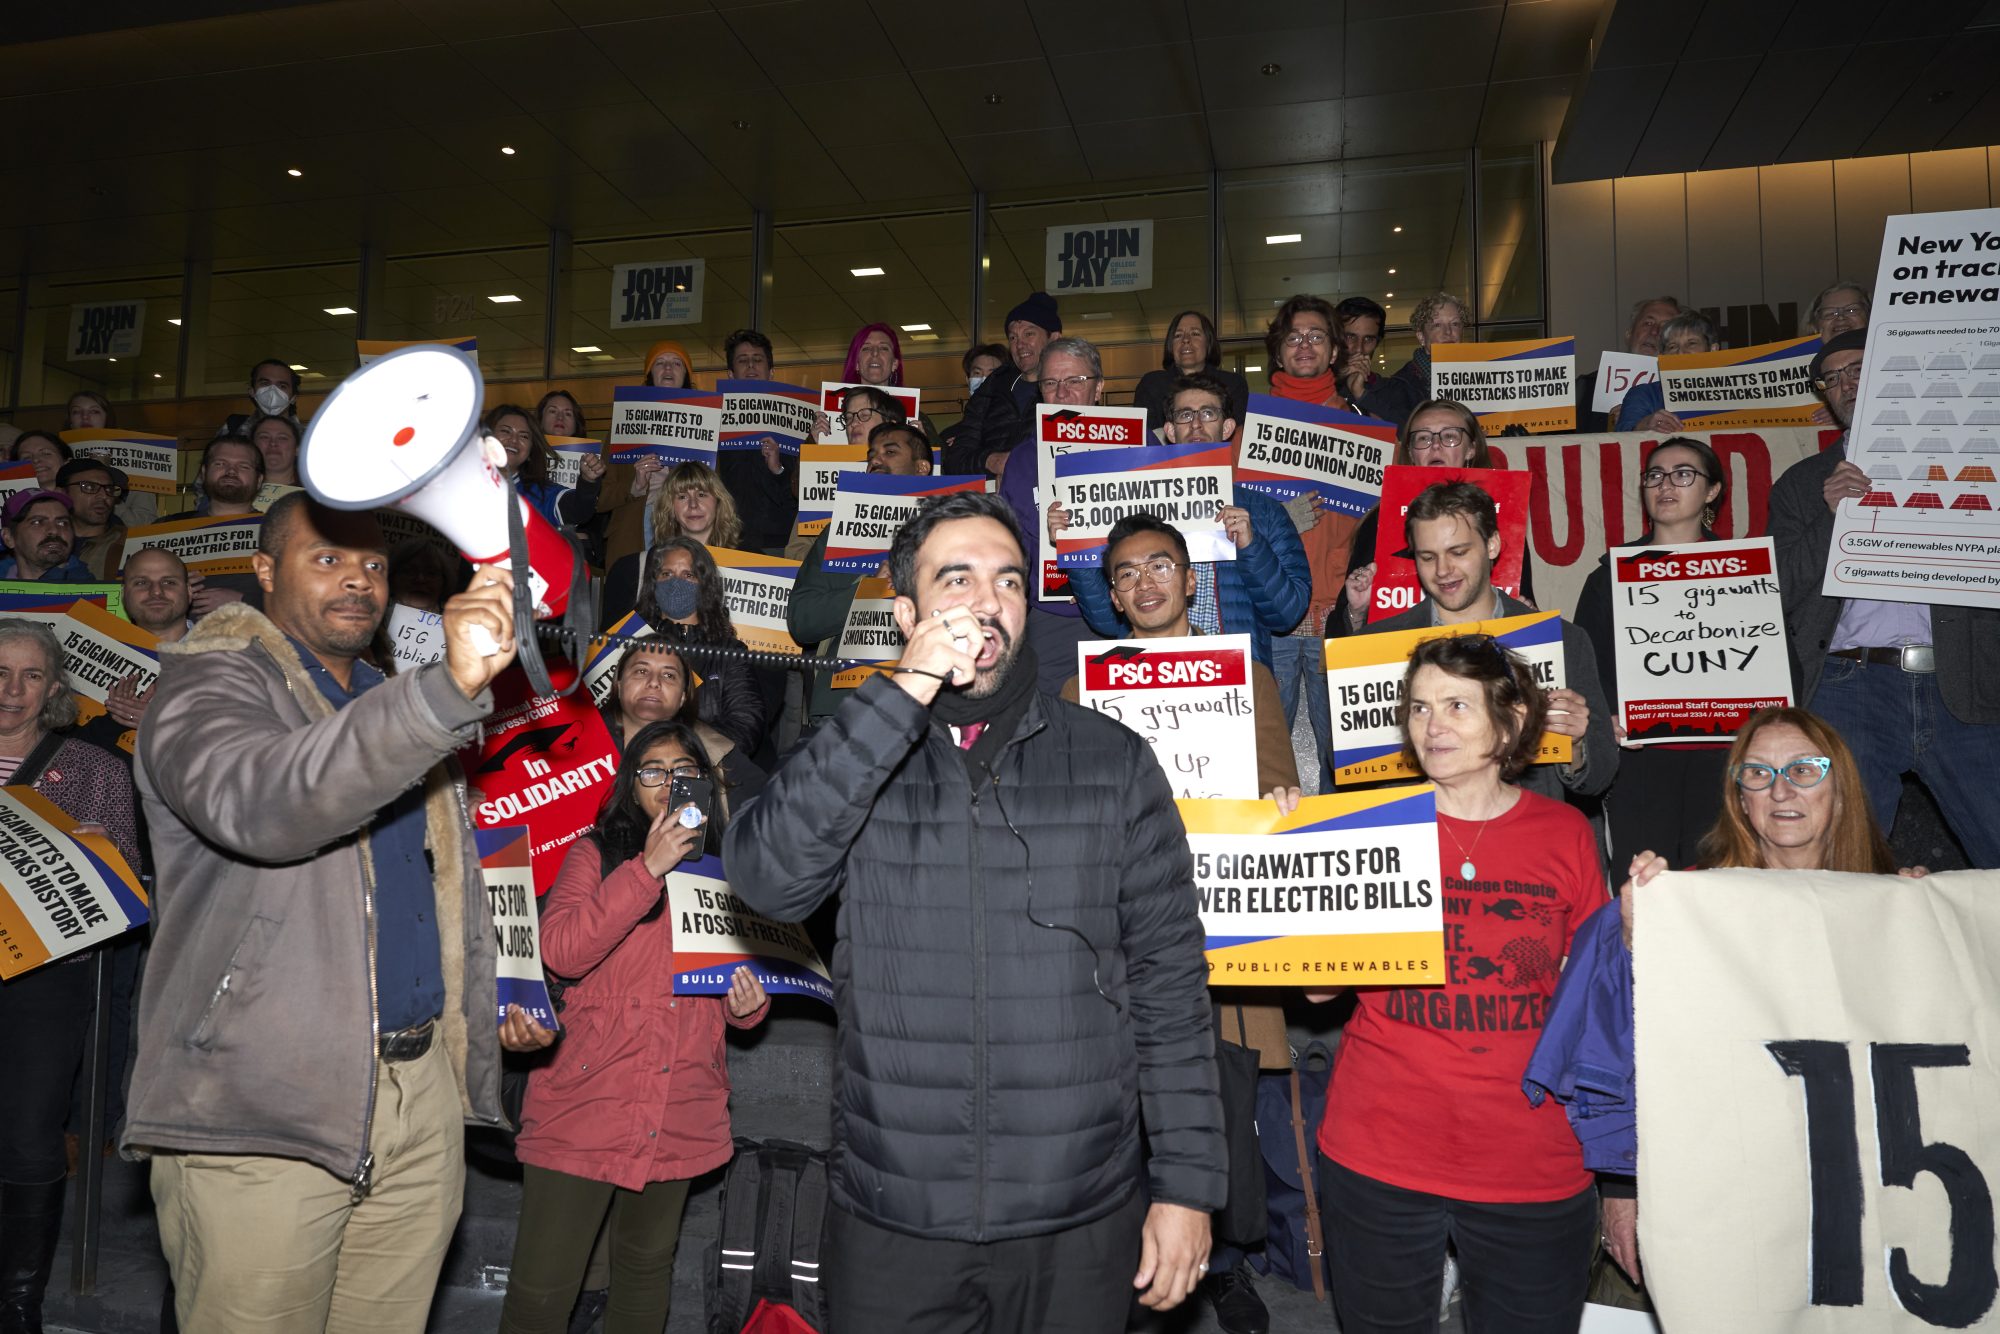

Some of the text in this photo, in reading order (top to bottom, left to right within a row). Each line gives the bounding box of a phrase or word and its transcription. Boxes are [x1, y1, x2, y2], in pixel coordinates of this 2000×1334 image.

[1058, 227, 1140, 261] JOHN
[1897, 236, 1964, 256] New
[1058, 257, 1111, 288] JAY
[1893, 259, 2000, 280] on trac
[622, 265, 693, 297] JOHN
[621, 291, 668, 322] JAY
[1888, 288, 2000, 306] renewa
[78, 304, 137, 333] JOHN
[75, 329, 114, 355] JAY
[1886, 329, 1898, 337] 36
[1898, 328, 1936, 337] gigawatts
[1976, 326, 1988, 334] be
[1436, 366, 1567, 386] 15 GIGAWATTS TO MAKE
[1666, 364, 1810, 390] 15 GIGAWATTS TO MAK
[1436, 382, 1570, 401] SMOKESTACKS HISTORY
[1669, 381, 1814, 402] SMOKESTACKS HISTOR
[625, 410, 703, 426] 15 GIGAWATTS TO
[726, 399, 814, 420] 15 GIGAWATTS FOR
[615, 423, 714, 441] A FOSSIL-FREE FUTURE
[722, 412, 812, 434] 25,000 UNION JOB
[1056, 422, 1129, 441] PSC SAYS:
[1256, 422, 1382, 466] 15 GIGAWATTS FOR
[130, 449, 171, 462] TO MAKE
[130, 460, 172, 472] HISTORY
[1248, 442, 1384, 486] 25,000 UNION JOBS
[816, 471, 829, 484] 15
[1241, 482, 1272, 493] BUILD
[803, 487, 836, 500] LOWE
[1068, 476, 1219, 504] 15 GIGAWATTS FOR
[854, 504, 918, 522] 15 GIGAWA
[1066, 506, 1124, 530] 25,000
[158, 531, 228, 550] GIGAWATTS
[230, 530, 254, 540] FOR
[836, 521, 900, 538] A FOSSIL-F
[174, 540, 259, 558] ELECTRIC BILL
[1847, 538, 2000, 555] 3.5GW of renewables NYPA pla
[828, 560, 857, 568] BUILD
[1064, 554, 1098, 562] BUILD
[1638, 557, 1748, 579] PSC SAYS:
[1844, 566, 2000, 586] 7 gigawatts being developed by
[768, 586, 792, 602] FOR
[1628, 578, 1780, 608] 15 gigawatts
[725, 596, 768, 616] ECTRIC
[1674, 610, 1696, 620] to
[849, 610, 894, 627] 15 GIGAWAT
[398, 625, 416, 640] 15
[843, 630, 908, 646] SMOKESTACK
[1625, 620, 1780, 644] Decarbonize
[64, 630, 84, 648] 15
[79, 638, 148, 685] GIGAWATTS
[1644, 645, 1758, 676] CUNY
[1108, 659, 1222, 686] PSC SAYS:
[1338, 684, 1360, 706] 15
[1092, 688, 1253, 730] 15 gigawatts
[1628, 700, 1784, 712] Professional Staff Congress/CUNY
[1629, 712, 1651, 720] NYSUT
[522, 758, 552, 779] In
[1174, 753, 1210, 779] Up
[1344, 764, 1388, 776] BUILD
[478, 753, 617, 825] SOLIDARITY
[540, 832, 576, 852] AFT Local
[52, 862, 80, 885] TO
[1190, 846, 1401, 880] 15 GIGAWATTS FOR
[1246, 879, 1433, 913] ELECTRIC BILLS
[1444, 876, 1558, 899] College Chapter
[26, 874, 86, 940] HISTORY
[65, 883, 109, 928] MAKE
[508, 884, 529, 917] FOR
[694, 888, 714, 910] 15
[682, 912, 785, 946] A FOSSIL-FREE
[506, 926, 534, 960] JOBS
[1226, 962, 1292, 972] PUBLIC
[1302, 960, 1429, 972] RENEWABLES
[682, 974, 779, 984] BUILD LIC
[1386, 989, 1551, 1032] ORGANIZE
[1763, 1039, 1999, 1329] 15
